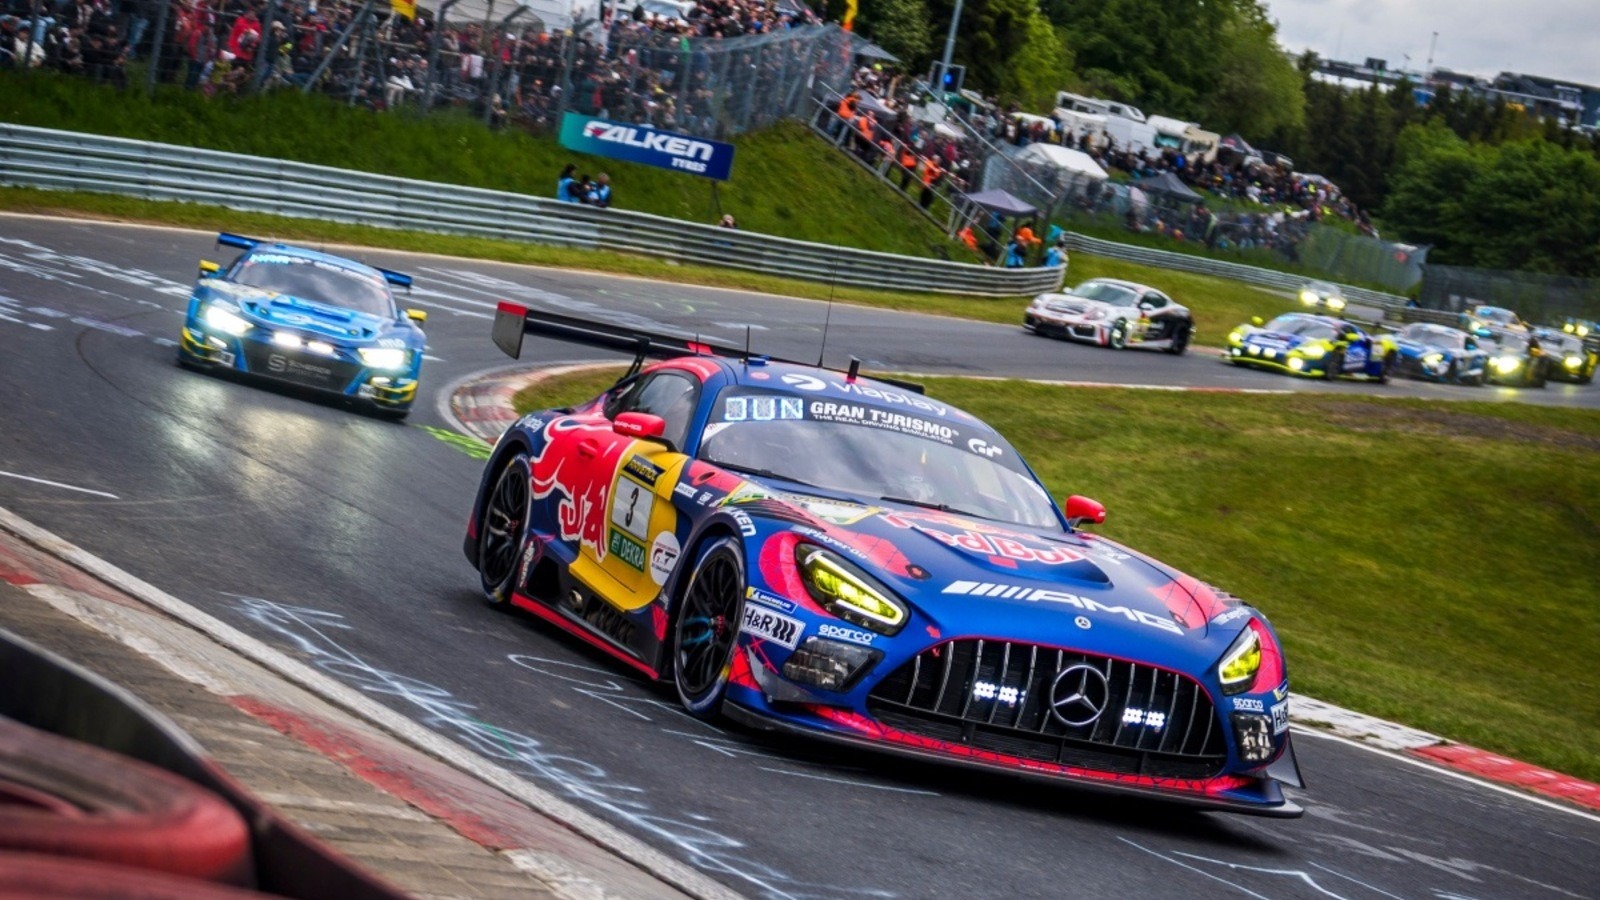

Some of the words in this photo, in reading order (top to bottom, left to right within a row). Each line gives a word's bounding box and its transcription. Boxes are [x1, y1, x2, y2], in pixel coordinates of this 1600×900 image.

[582, 120, 714, 161] FALKEN
[671, 157, 708, 173] TYRES
[724, 398, 804, 421] JUN
[830, 381, 947, 416] viaplay
[810, 401, 865, 419] GRAN
[869, 409, 953, 438] TURISMO
[835, 416, 860, 425] REAL
[861, 419, 901, 431] DRIVING
[902, 427, 954, 445] SIMULATOR
[625, 486, 639, 528] 3
[620, 538, 645, 572] DEKRA
[988, 535, 1084, 565] Bul
[743, 607, 773, 632] H&R
[1026, 589, 1185, 636] AMG
[818, 623, 873, 643] sparco
[1232, 697, 1264, 711] sparco
